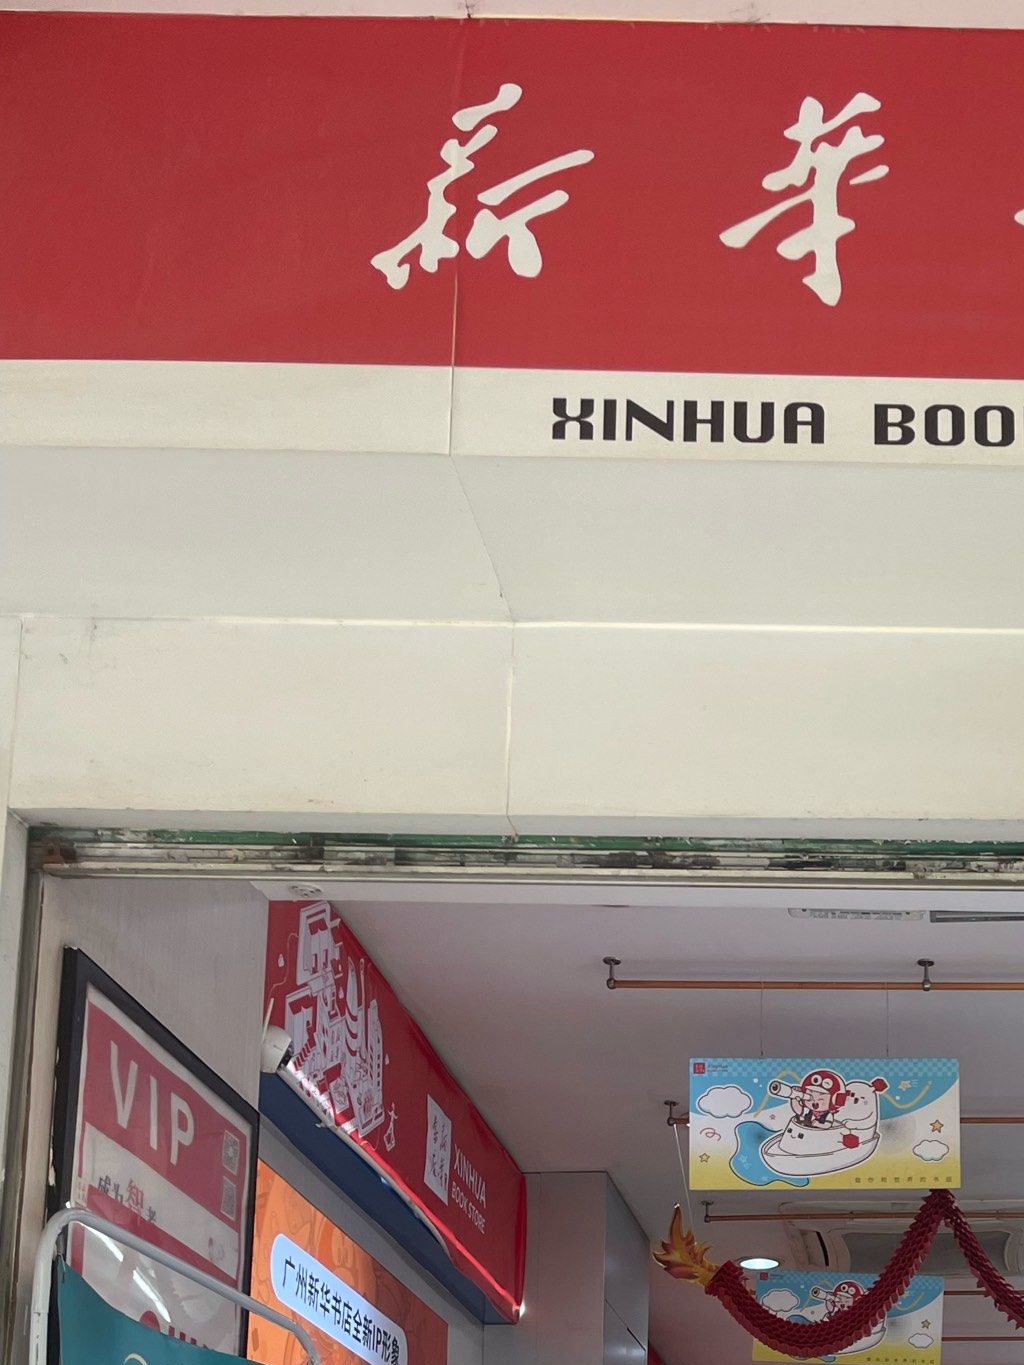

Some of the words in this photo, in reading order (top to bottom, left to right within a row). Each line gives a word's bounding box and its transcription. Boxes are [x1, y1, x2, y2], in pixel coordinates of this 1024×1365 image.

[552, 396, 826, 444] XINHUA
[110, 1040, 195, 1166] VIP
[454, 1143, 488, 1209] XINHUA
